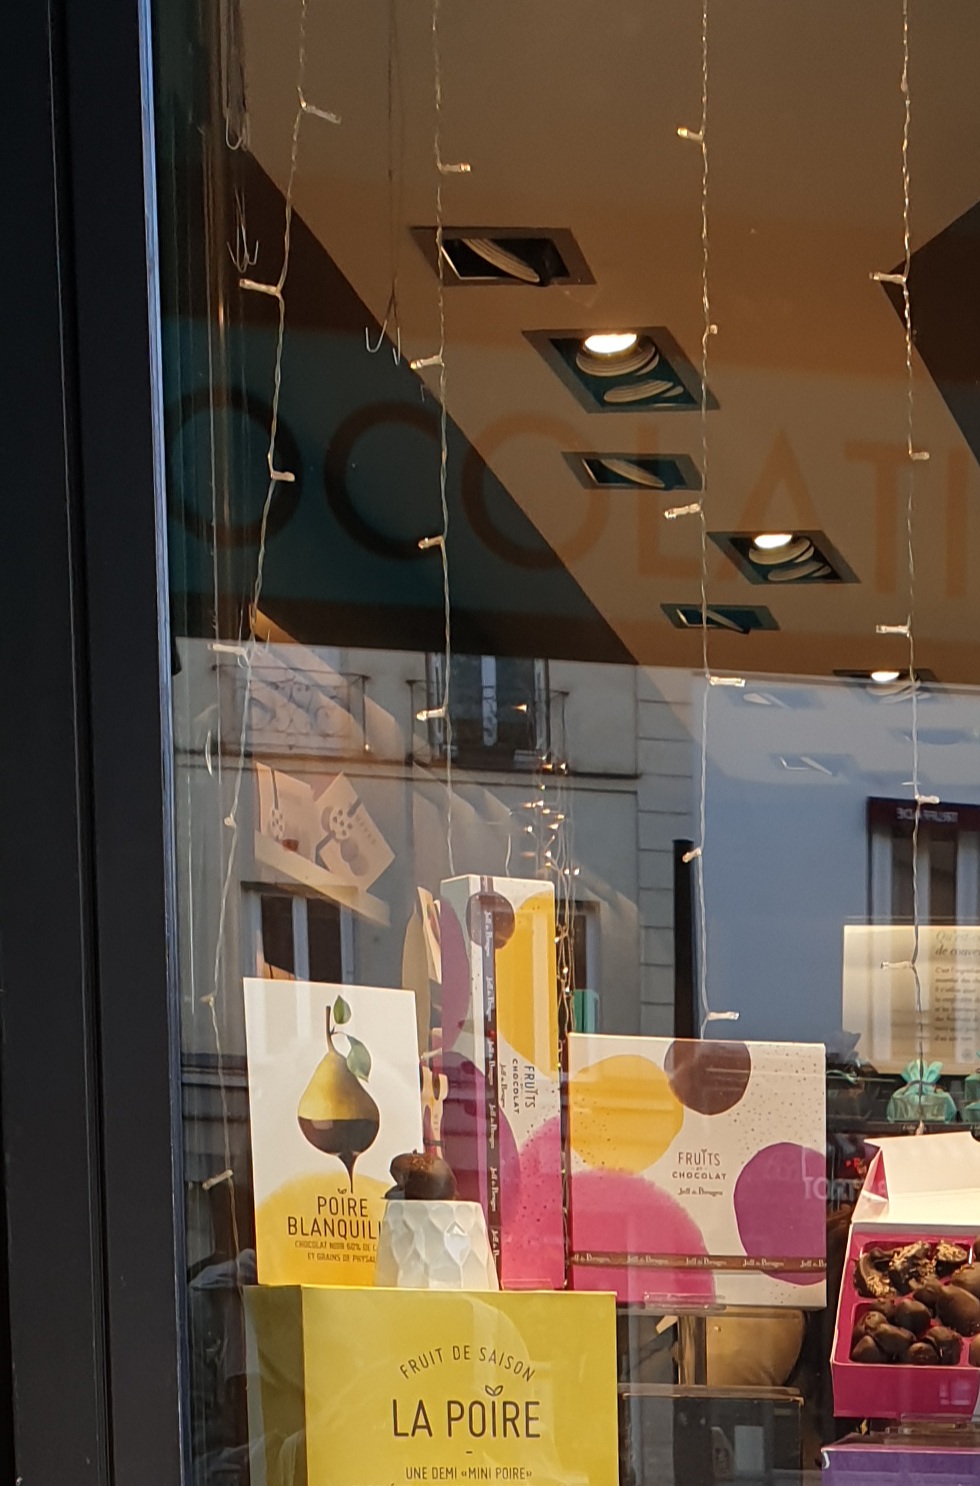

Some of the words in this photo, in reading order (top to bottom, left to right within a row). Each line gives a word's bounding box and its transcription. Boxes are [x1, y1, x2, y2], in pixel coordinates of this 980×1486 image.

[935, 946, 948, 955] de
[678, 1149, 720, 1166] FRUITS
[672, 1171, 727, 1180] CHOCOLAT
[317, 1196, 368, 1217] POIRE
[295, 1240, 327, 1248] CHOCOLAT
[317, 1253, 340, 1261] GRAINS
[342, 1254, 350, 1262] DE
[399, 1346, 446, 1381] FRUIT
[452, 1345, 472, 1361] DE
[478, 1346, 537, 1384] SAISON
[392, 1398, 434, 1439] LA
[446, 1399, 542, 1439] POIRE
[405, 1466, 428, 1480] UNE
[431, 1466, 458, 1480] DEMI
